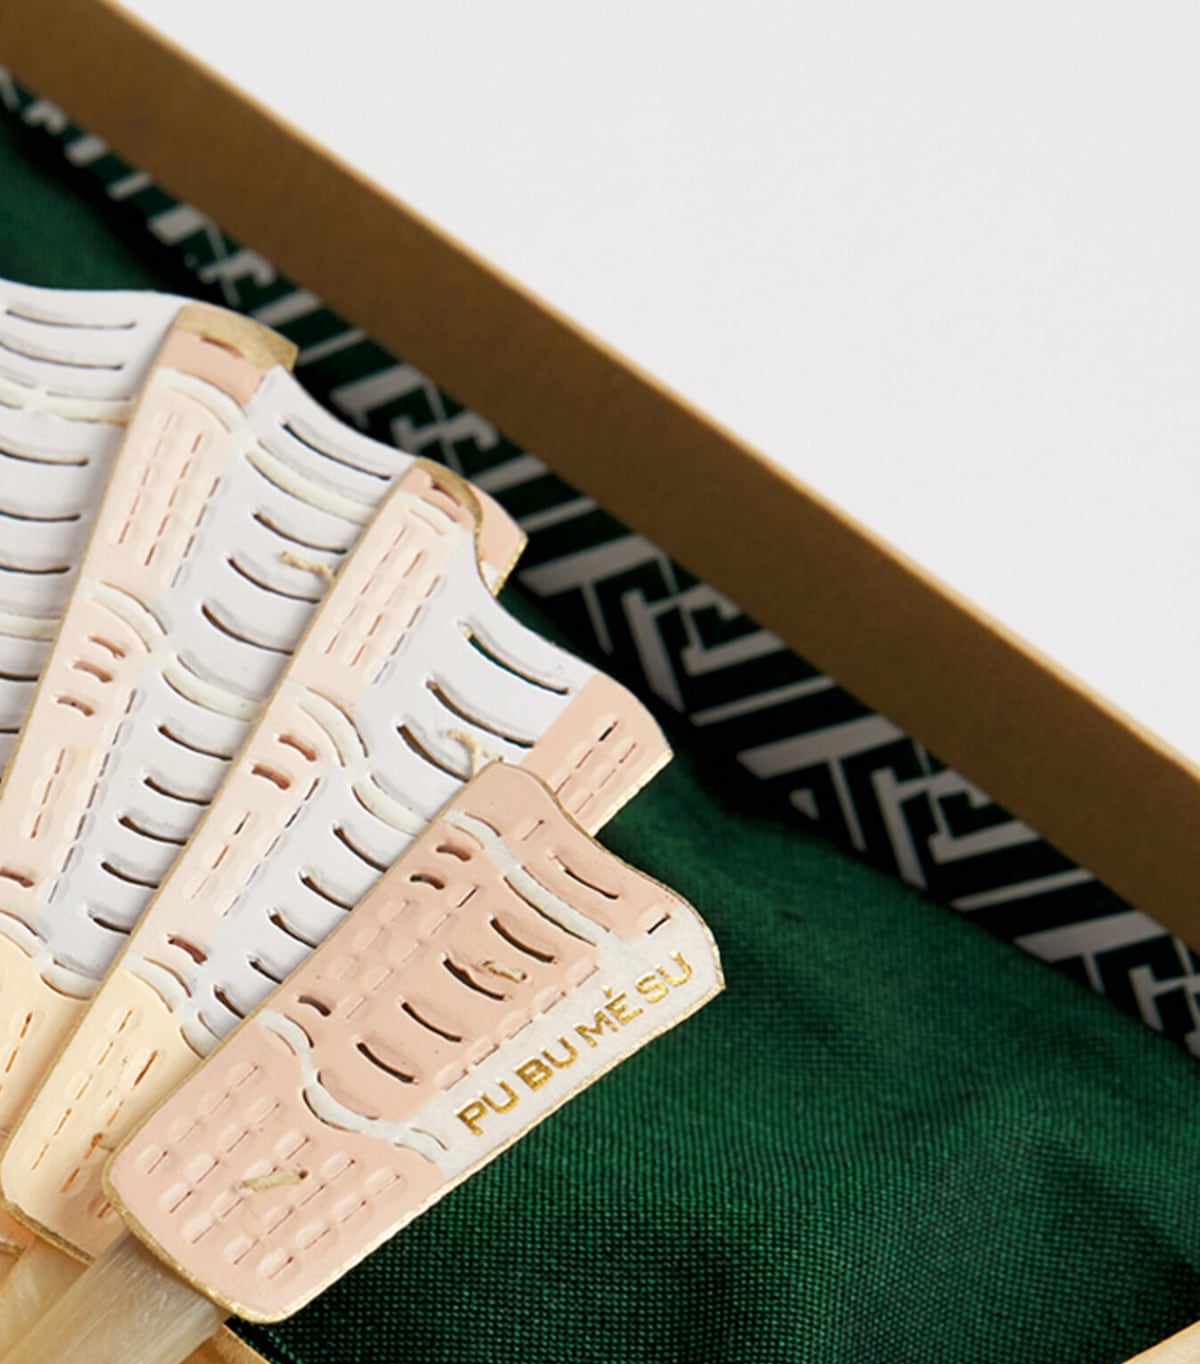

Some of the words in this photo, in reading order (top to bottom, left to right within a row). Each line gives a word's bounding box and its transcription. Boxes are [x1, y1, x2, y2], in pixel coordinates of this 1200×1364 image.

[455, 1079, 519, 1136] PU
[513, 1035, 578, 1091] BU
[635, 950, 692, 1004] SU
